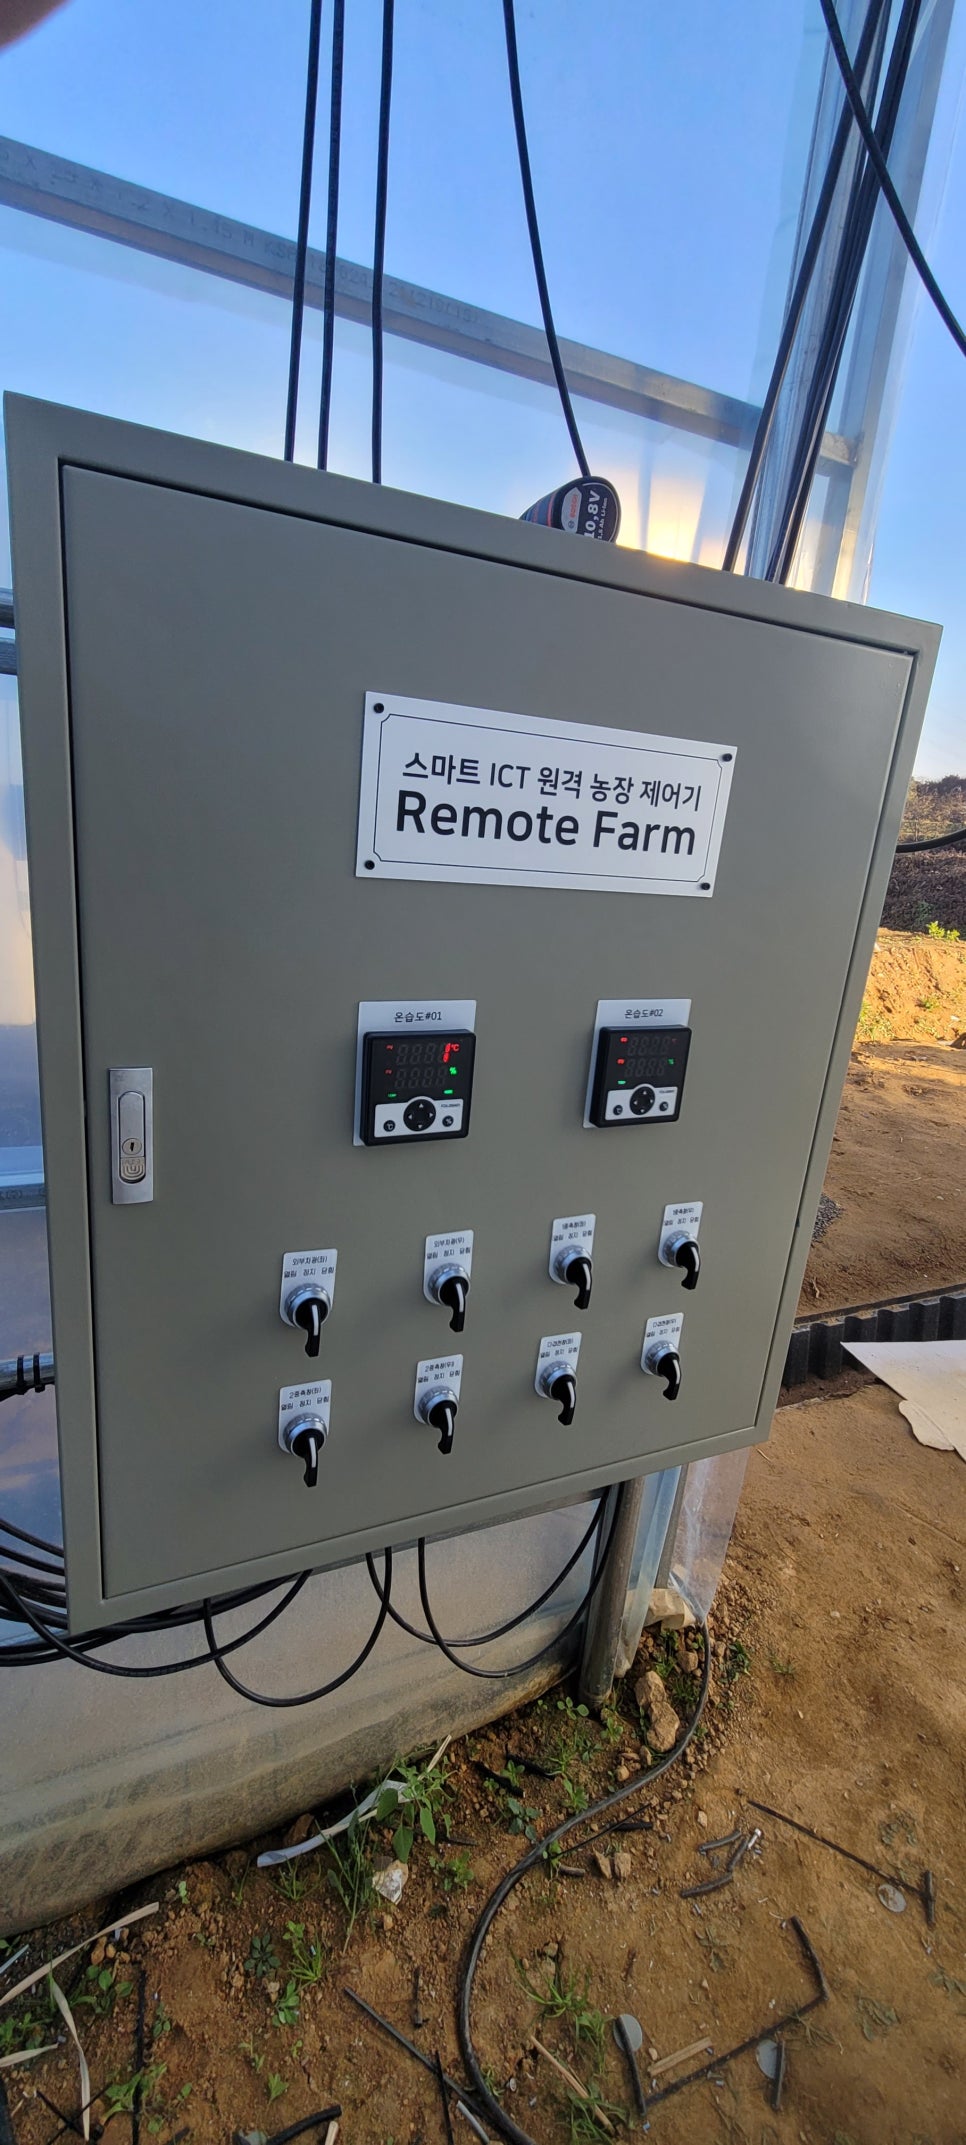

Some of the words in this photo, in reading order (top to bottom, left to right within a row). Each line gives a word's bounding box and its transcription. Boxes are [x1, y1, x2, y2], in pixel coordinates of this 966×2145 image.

[402, 752, 480, 786] 스마트
[489, 763, 531, 789] ICT
[537, 767, 582, 799] 원격
[590, 773, 634, 805] 농장
[639, 779, 702, 812] 제어기
[396, 789, 579, 846] Remote
[593, 810, 696, 856] Farm
[394, 1011, 442, 1023] 온습도#01
[624, 1009, 664, 1019] 온습도#02
